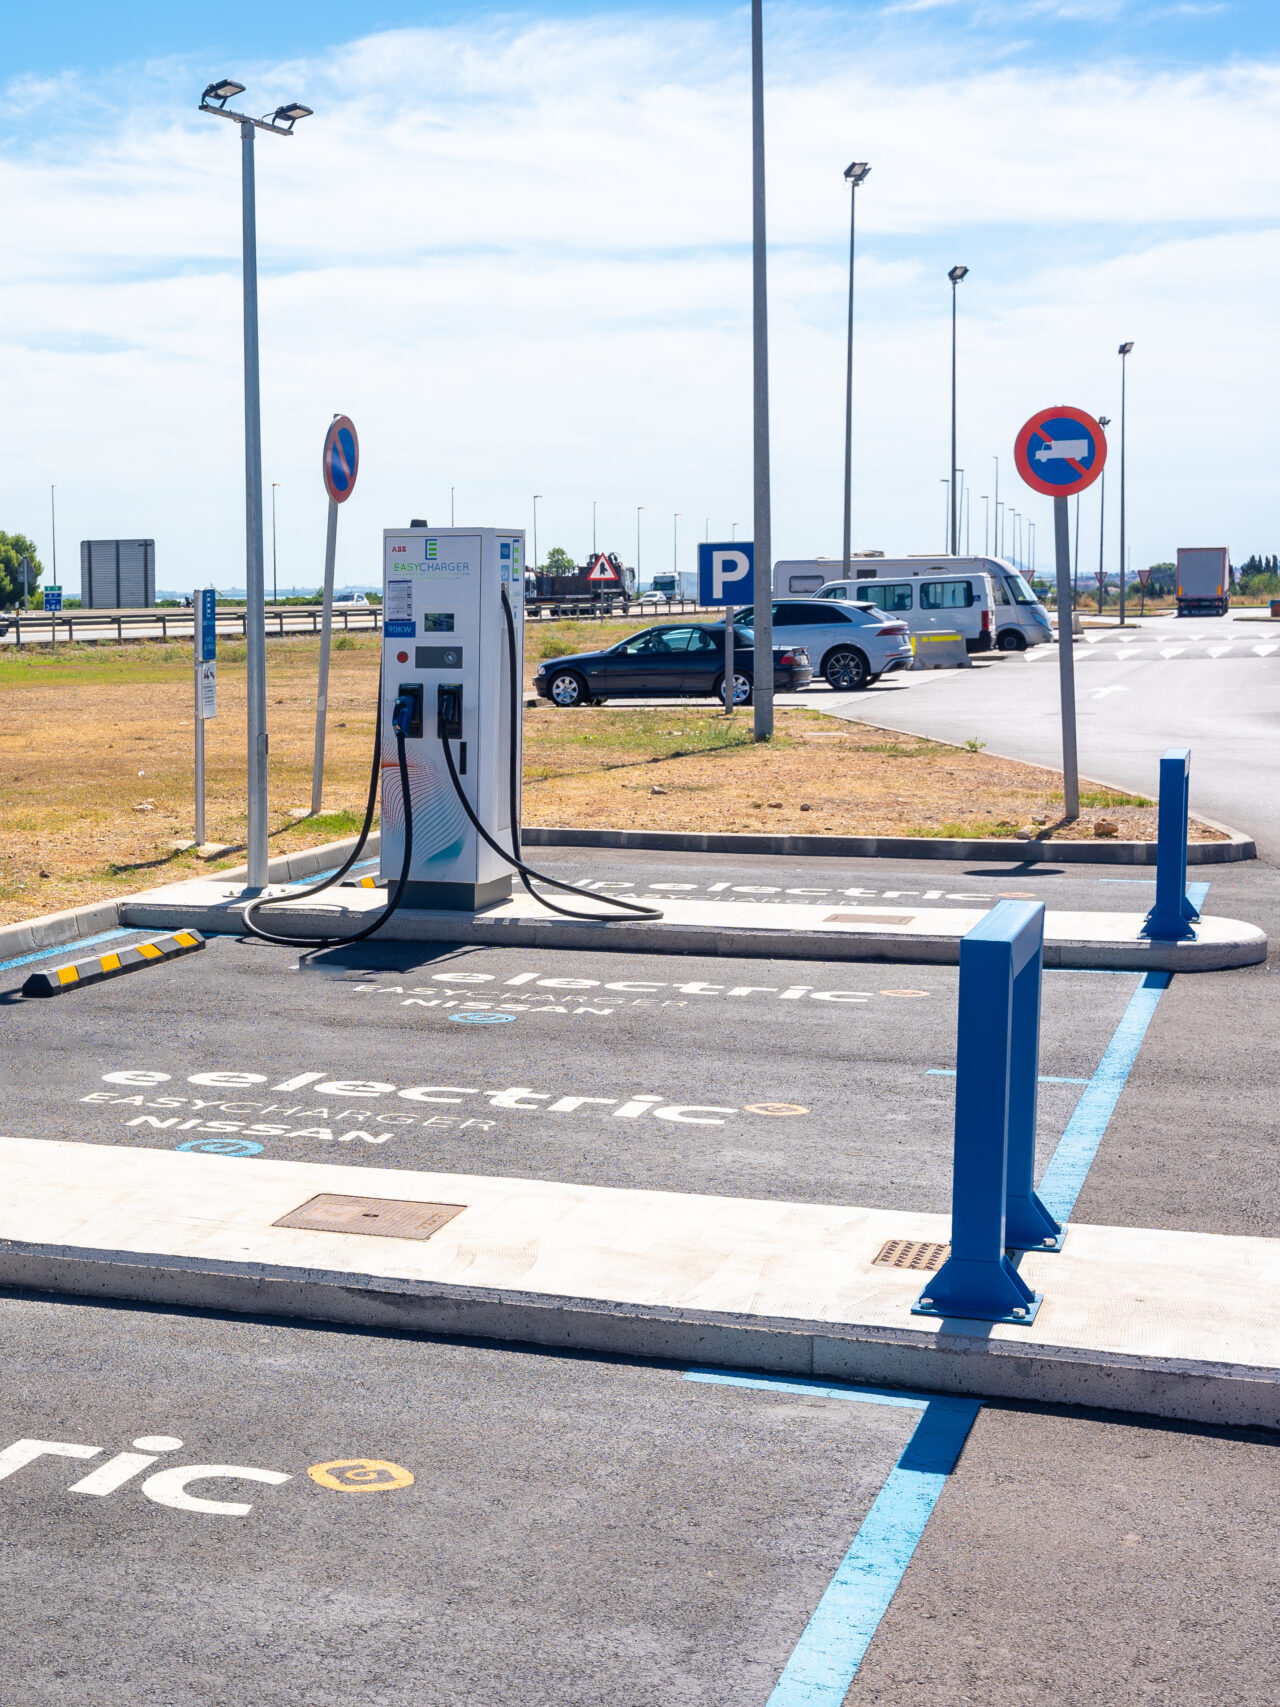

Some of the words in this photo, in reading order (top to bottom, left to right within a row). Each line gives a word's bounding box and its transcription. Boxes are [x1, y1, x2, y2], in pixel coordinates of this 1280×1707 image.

[391, 545, 407, 553] ABB
[394, 562, 469, 572] EASYCHARGER
[712, 550, 749, 599] P
[388, 625, 412, 633] 90KW
[649, 882, 994, 901] electric
[352, 985, 689, 1007] EASYCHARGER
[431, 972, 875, 1003] electric
[400, 998, 616, 1016] NISSAN
[187, 1071, 739, 1125] electric
[79, 1092, 497, 1132] EASYCHARGER
[125, 1115, 394, 1144] NISSAN
